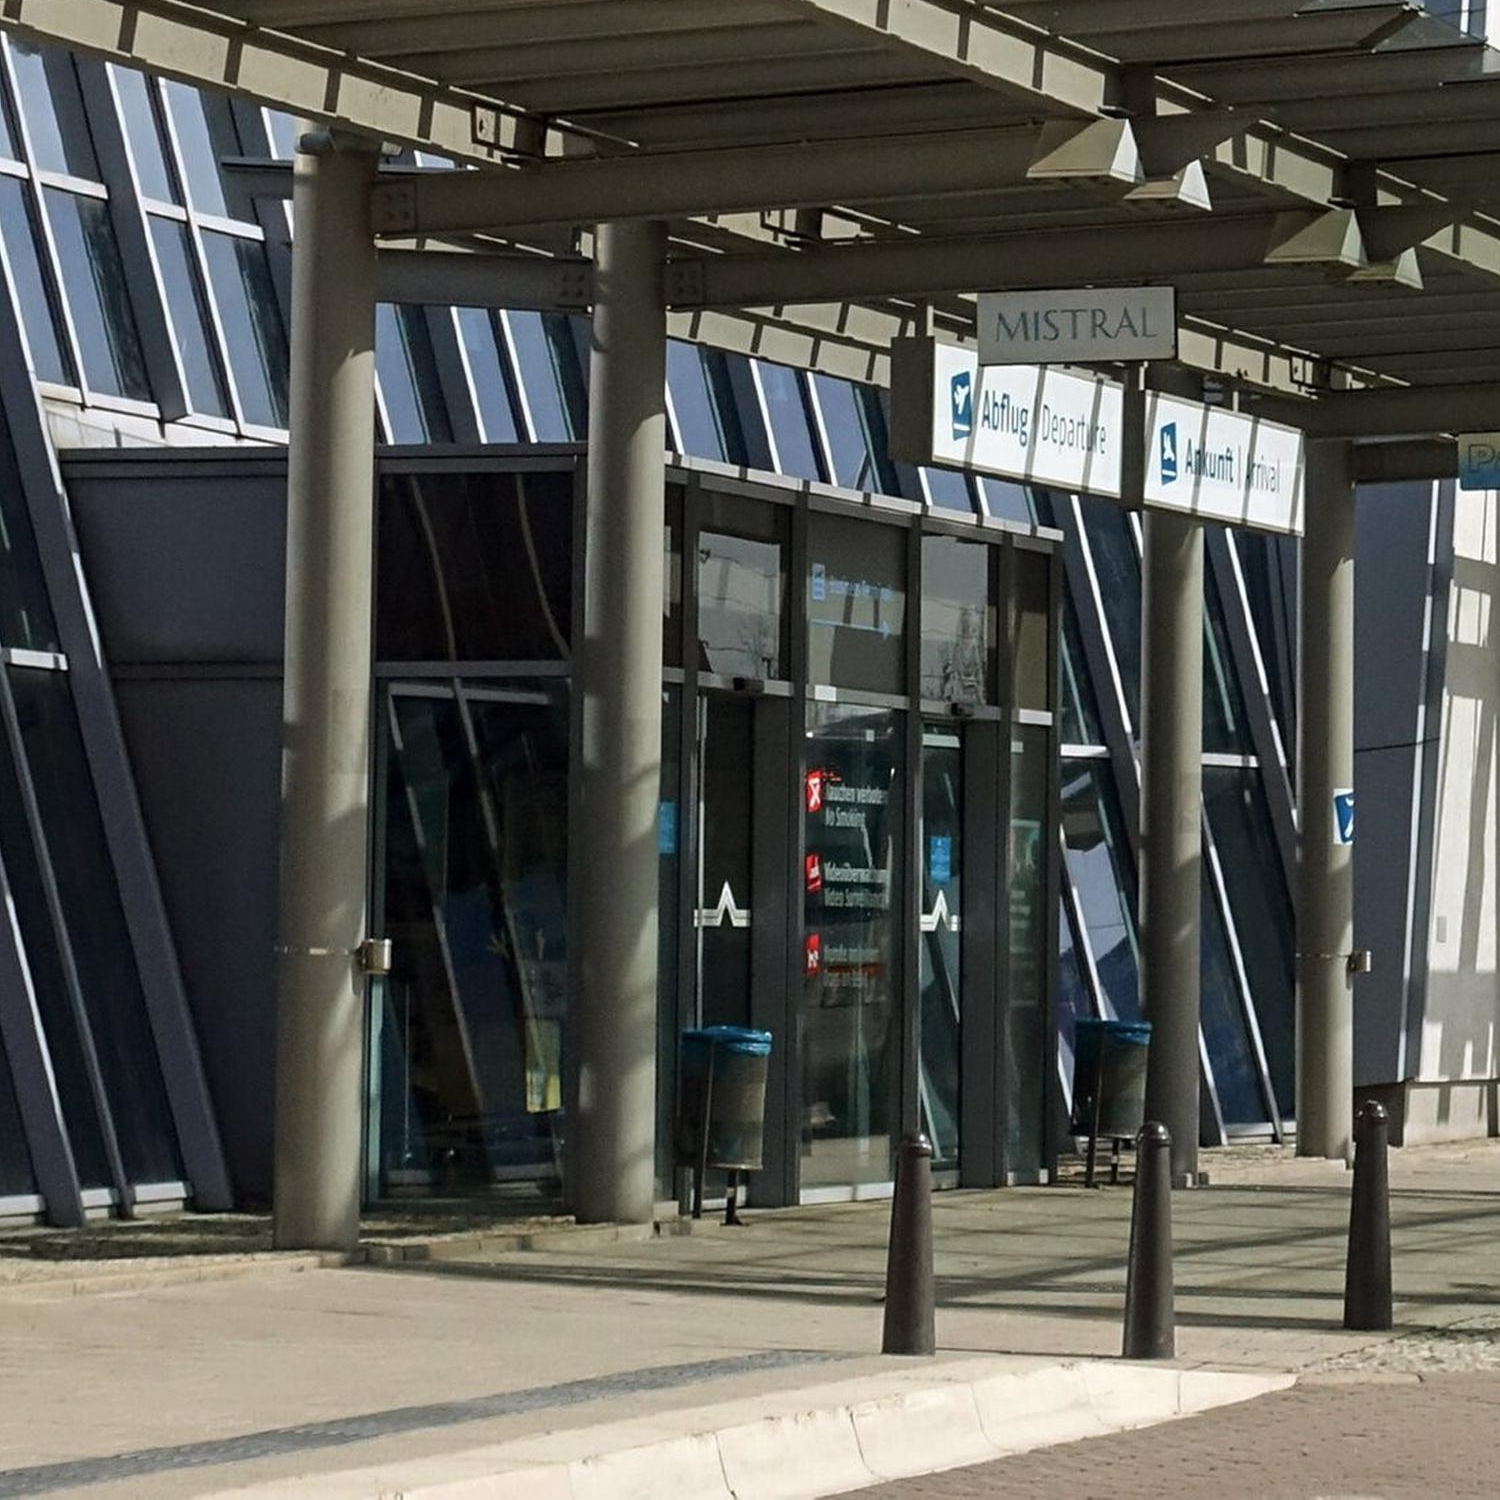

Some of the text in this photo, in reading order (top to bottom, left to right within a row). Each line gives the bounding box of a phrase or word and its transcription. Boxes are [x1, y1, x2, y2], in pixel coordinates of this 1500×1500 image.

[996, 307, 1158, 342] MISTRAL
[981, 389, 1107, 455] Abflug Departure
[1185, 438, 1234, 483] Ankunft
